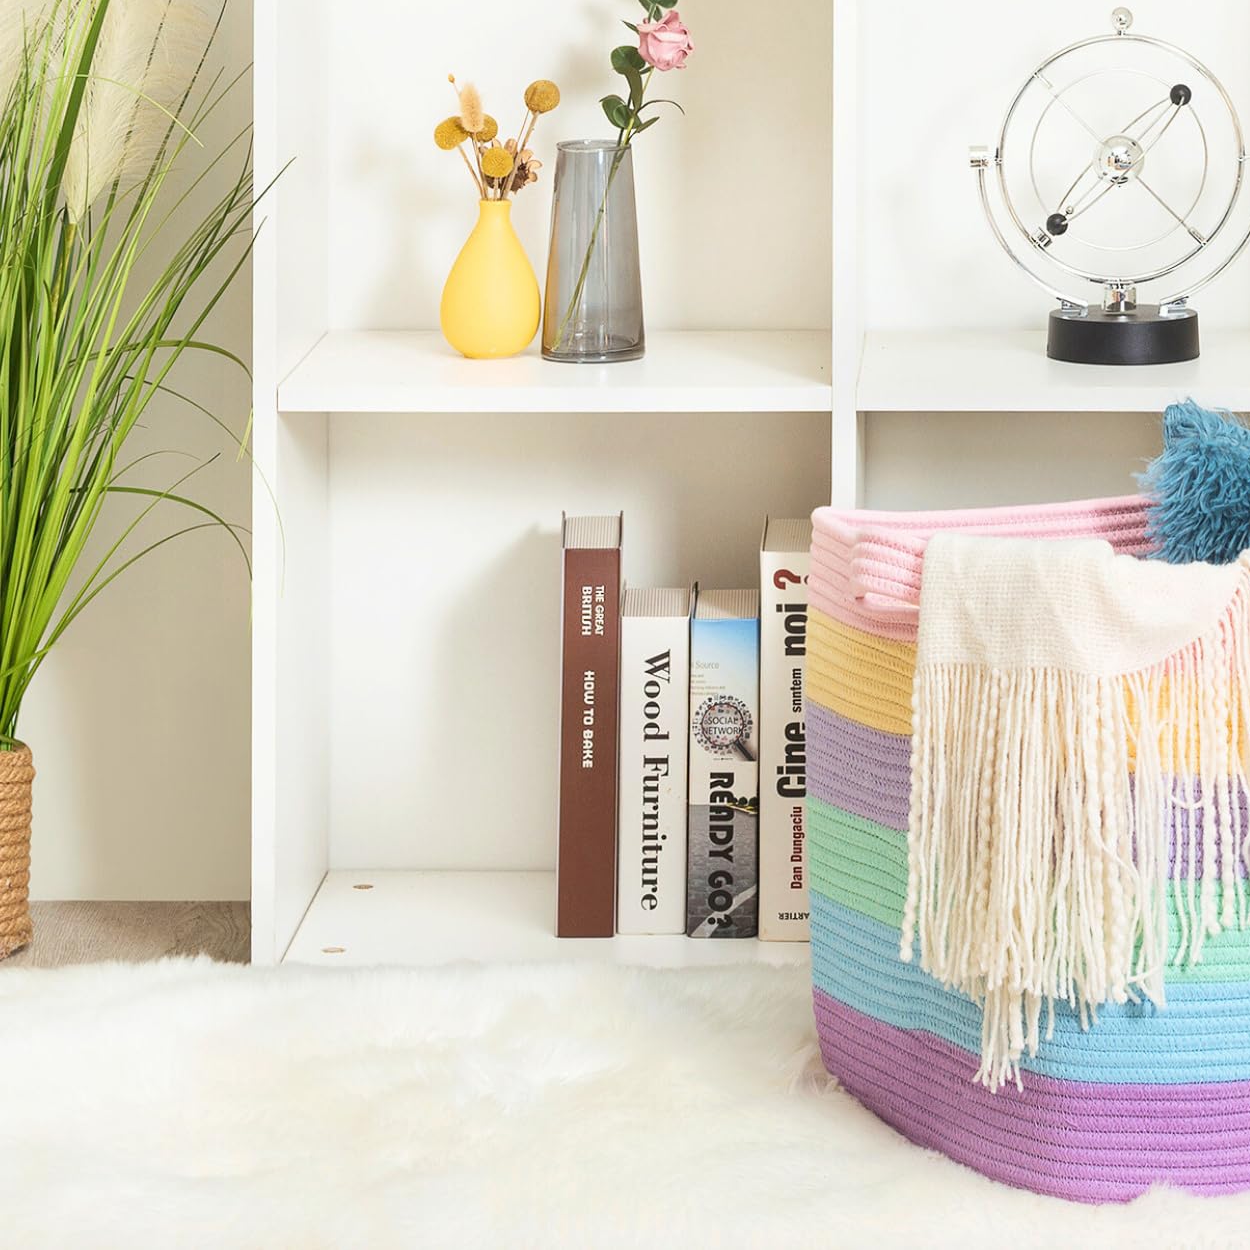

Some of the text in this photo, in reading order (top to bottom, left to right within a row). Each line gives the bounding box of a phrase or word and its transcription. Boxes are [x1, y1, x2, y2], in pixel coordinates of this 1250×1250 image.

[594, 585, 605, 636] THE GREAT
[776, 603, 808, 656] noi
[582, 670, 595, 768] HOW TO BAKE
[707, 716, 739, 725] SOCIAL
[641, 648, 671, 911] Wood Furniture
[776, 721, 807, 798] Cine
[708, 771, 735, 863] READY
[790, 806, 805, 889] Dan Dungaciu
